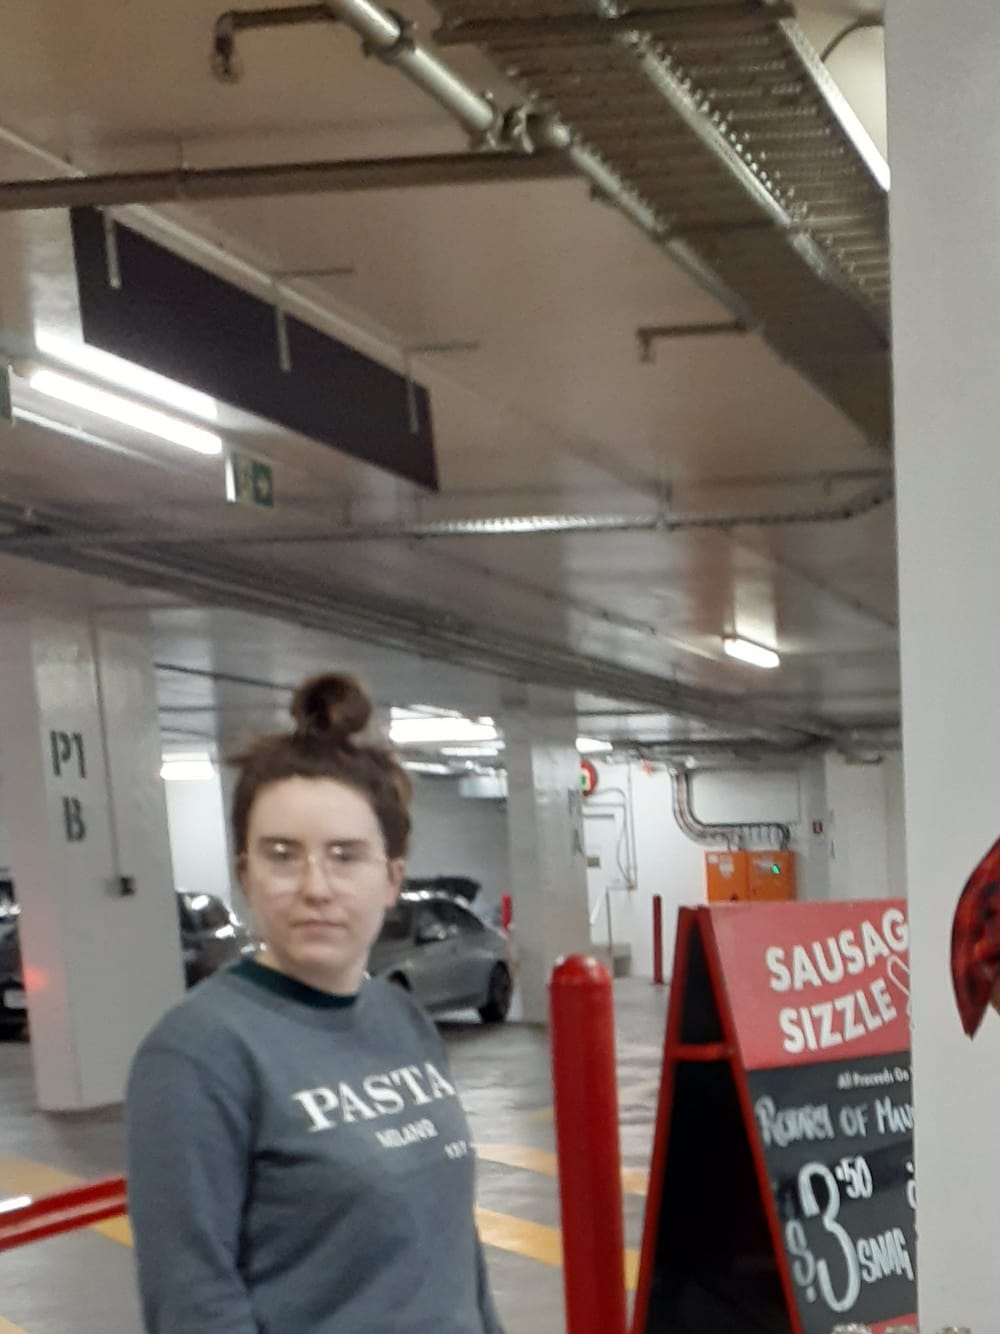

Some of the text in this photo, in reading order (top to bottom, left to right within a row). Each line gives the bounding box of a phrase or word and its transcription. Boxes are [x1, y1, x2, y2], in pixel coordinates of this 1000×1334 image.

[50, 730, 86, 779] P1
[62, 797, 86, 842] B
[765, 908, 910, 992] SAUSAG
[779, 978, 898, 1053] SIZZLE
[293, 1061, 457, 1133] PASTA
